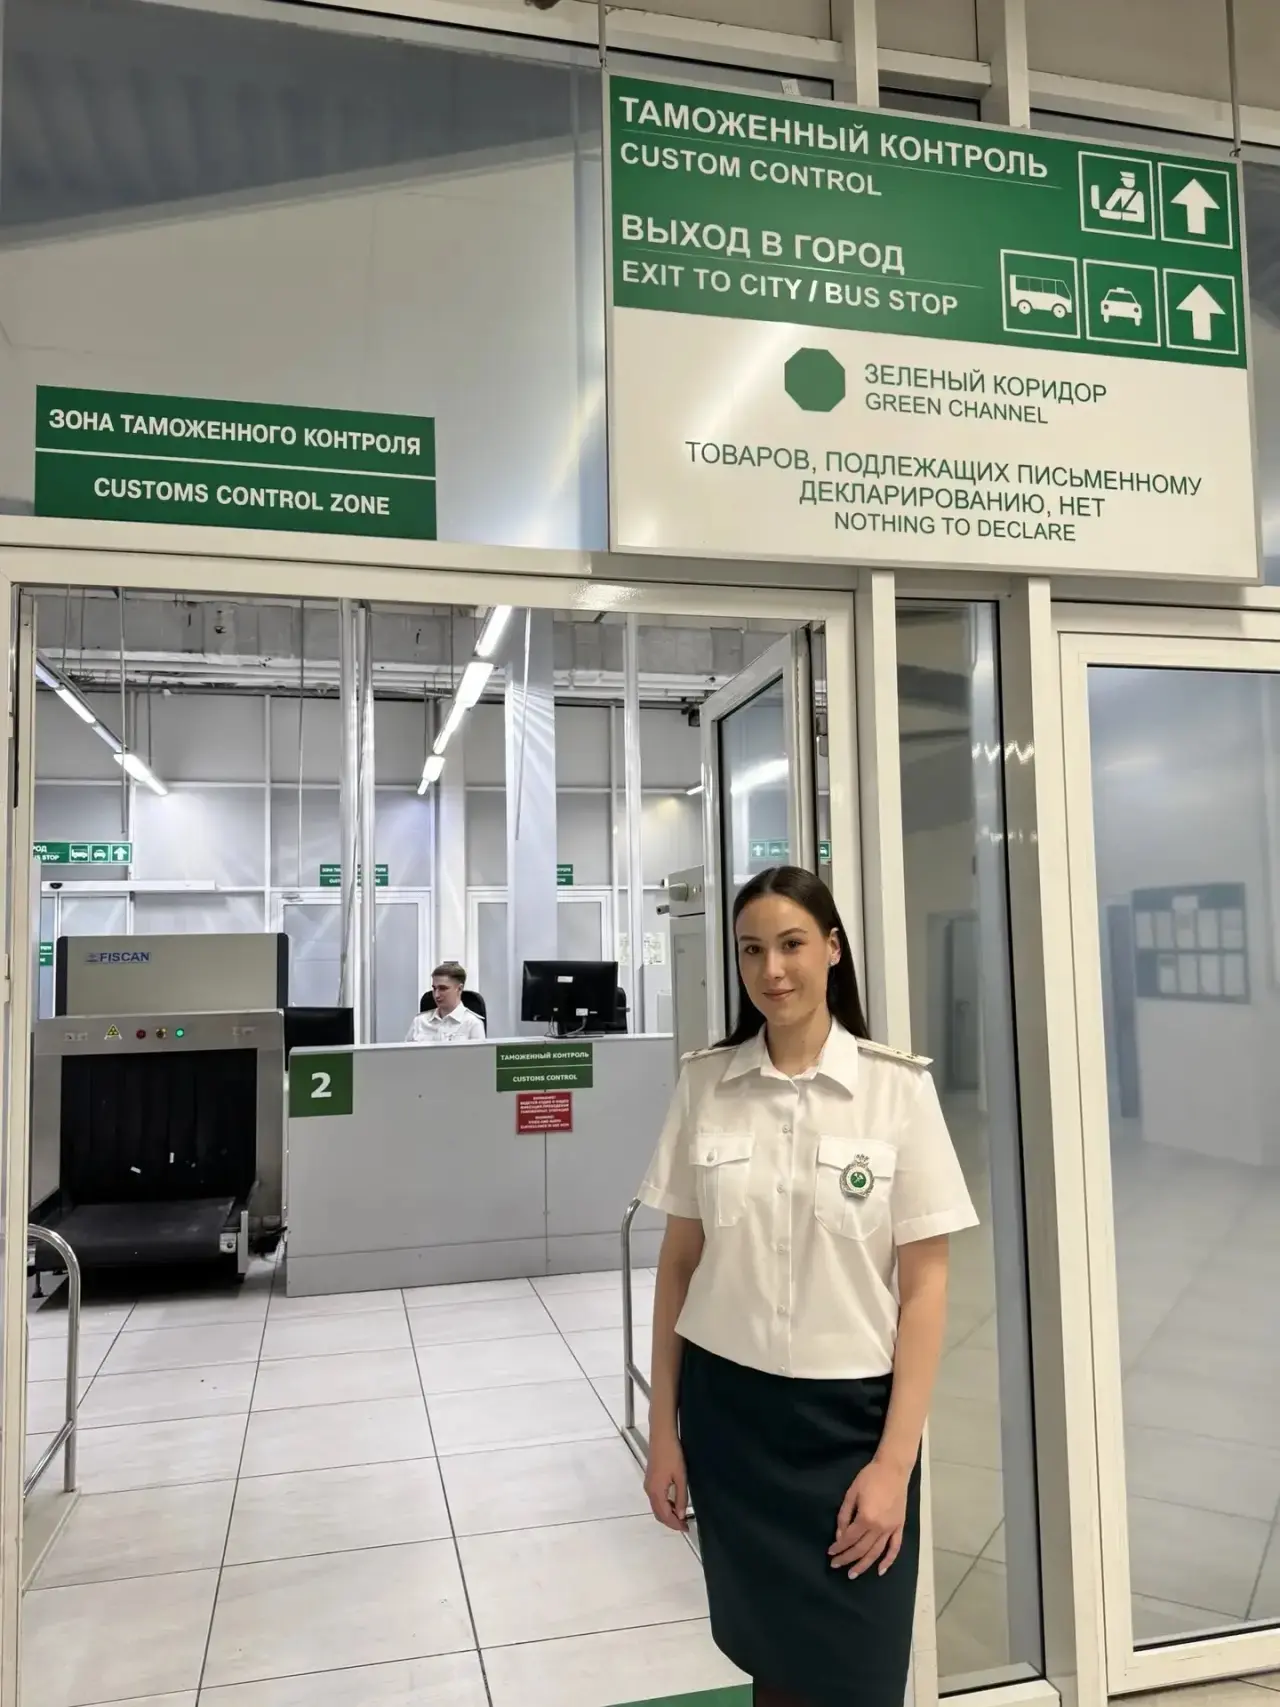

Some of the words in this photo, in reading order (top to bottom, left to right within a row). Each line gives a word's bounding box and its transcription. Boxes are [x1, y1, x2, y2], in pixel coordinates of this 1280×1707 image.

[618, 96, 868, 154] ТАМОЖЕННЫЙ
[881, 133, 1048, 178] КОНТРОЛЬ
[620, 142, 740, 178] CUSTOM
[750, 160, 882, 196] CONTROL
[622, 214, 750, 258] ВЫХОД
[762, 230, 783, 256] В
[795, 234, 905, 276] ГОРОД
[623, 260, 685, 287] EXIT
[693, 268, 731, 292] TO
[740, 274, 802, 300] CITY
[808, 280, 818, 302] /
[825, 282, 880, 308] BUS
[889, 290, 958, 316] STOP
[865, 363, 985, 393] ЗЕЛЕНЫЙ
[993, 375, 1107, 405] КОРИДОР
[865, 392, 941, 415] GREEN
[948, 399, 1048, 424] CHANNEL
[49, 409, 114, 432] ЗОНА
[120, 414, 297, 445] ТАМОЖЕННОГО
[304, 428, 421, 456] КОНТРОЛЯ
[685, 441, 816, 474] ТОВАРОВ,
[826, 451, 1010, 486] ПОДЛЕЖАЩИХ
[1017, 464, 1202, 496] ПИСЬМЕННОМУ
[94, 477, 209, 503] CUSTOMS
[216, 485, 324, 511] CONTROL
[330, 493, 390, 515] ZONE
[799, 480, 1051, 517] ДЕКЛАРИРОВАНИЮ,
[1060, 496, 1105, 518] НЕТ
[835, 512, 935, 534] NOTHING
[941, 517, 970, 536] TO
[978, 519, 1076, 542] DECLARE
[100, 952, 150, 962] FISCAN
[501, 1052, 551, 1060] ТАМОЖЕННЫЙ
[311, 1072, 332, 1098] 2
